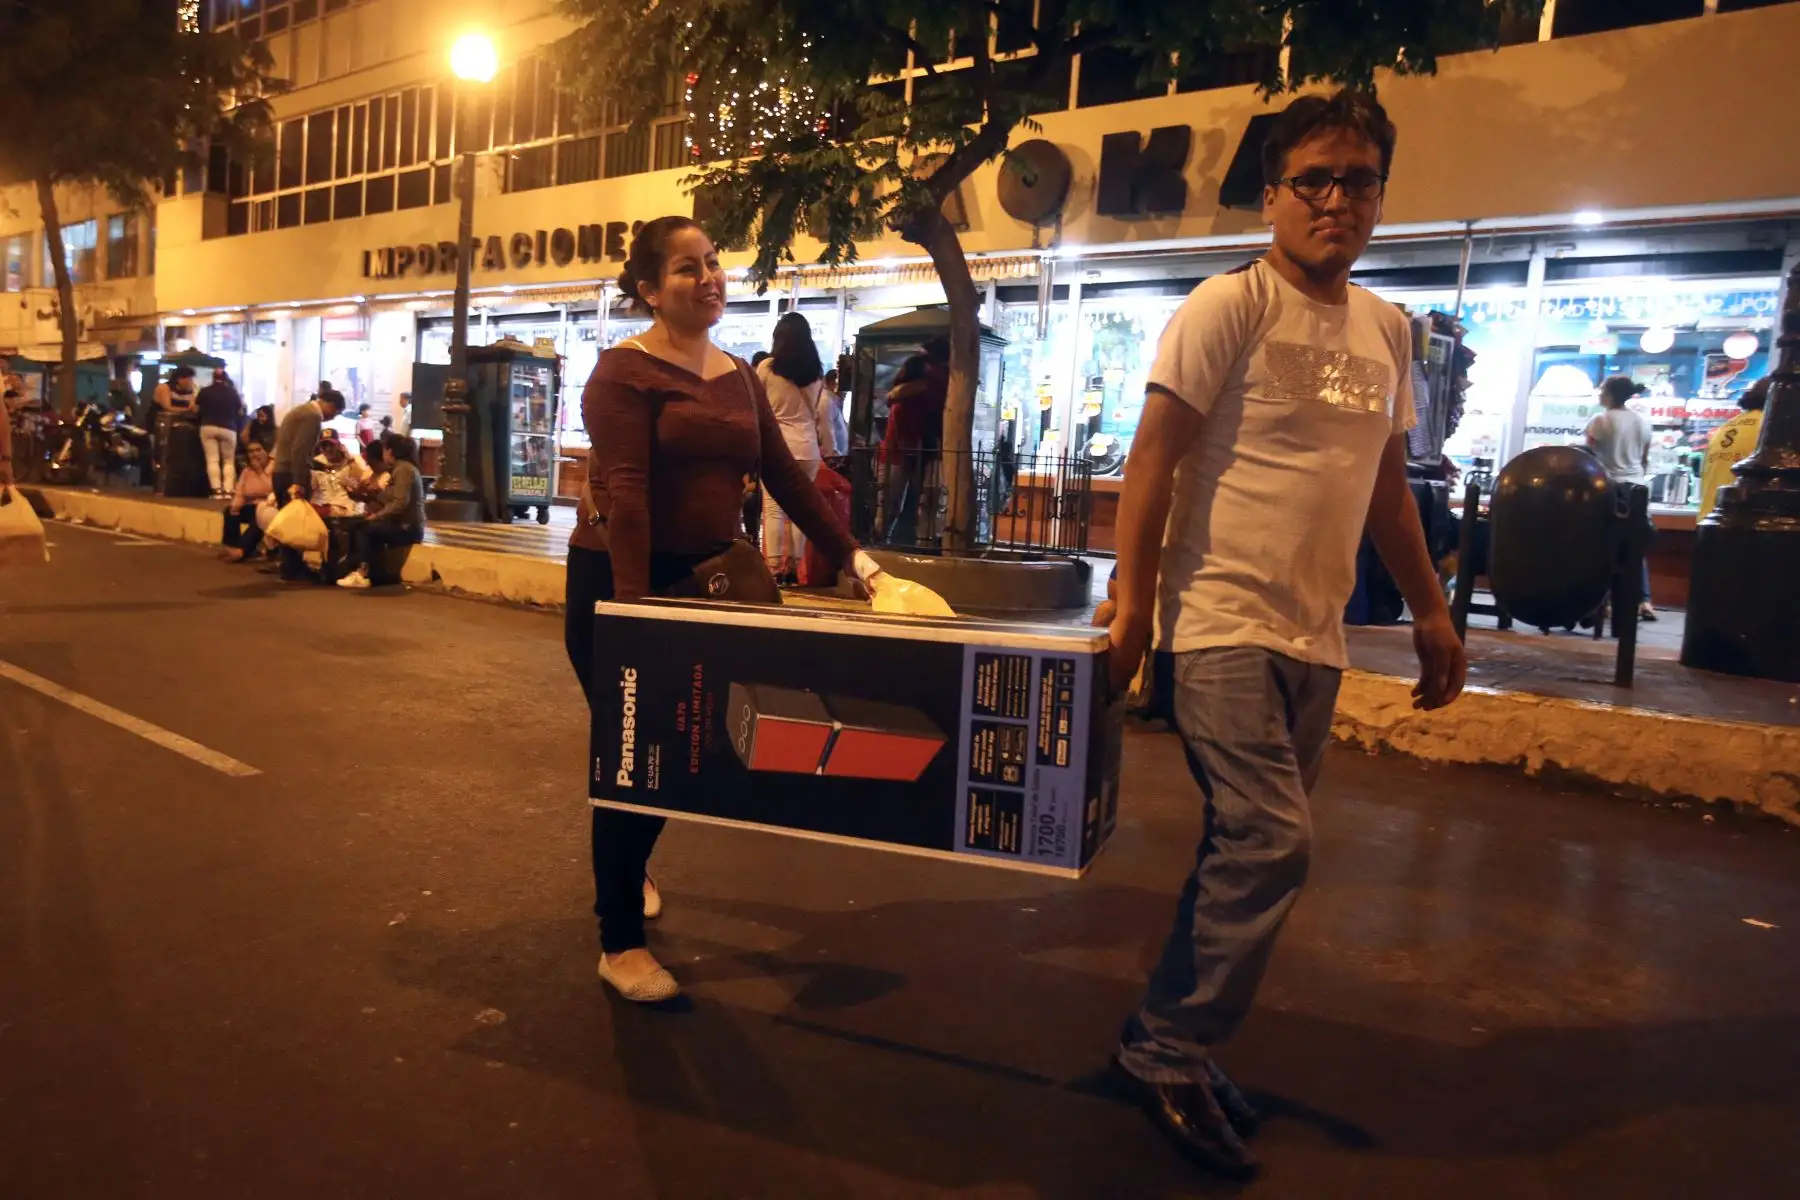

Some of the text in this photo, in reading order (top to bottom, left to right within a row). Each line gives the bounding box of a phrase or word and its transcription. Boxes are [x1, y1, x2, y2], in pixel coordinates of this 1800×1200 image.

[1524, 425, 1582, 436] nasonic
[616, 667, 637, 787] Panasonic
[677, 701, 687, 732] UA70
[689, 664, 703, 774] EDICION LIMITADA
[1037, 814, 1056, 856] 1700
